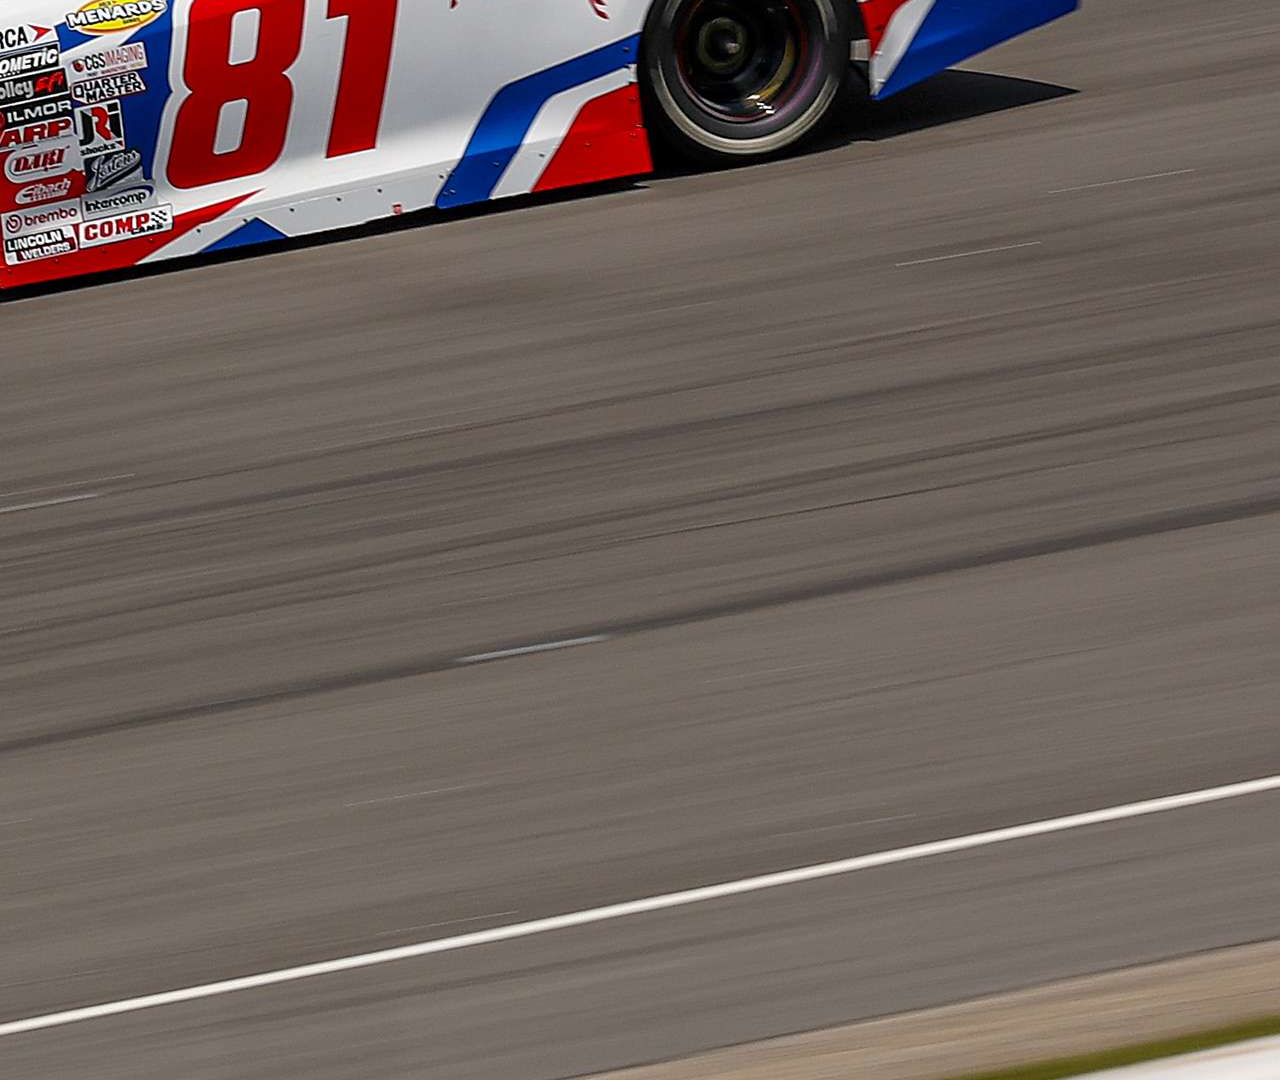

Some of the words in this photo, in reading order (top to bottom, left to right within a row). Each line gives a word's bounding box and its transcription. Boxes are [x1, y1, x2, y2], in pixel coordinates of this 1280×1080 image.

[73, 71, 137, 99] QUARTER
[86, 82, 143, 103] MASTER
[7, 100, 72, 123] ILMOR
[80, 142, 117, 156] shocks
[85, 190, 147, 212] Intercomp
[23, 206, 78, 227] brembo
[84, 212, 151, 241] COMP
[6, 230, 62, 251] LINCOLN
[20, 241, 71, 261] WELDERS
